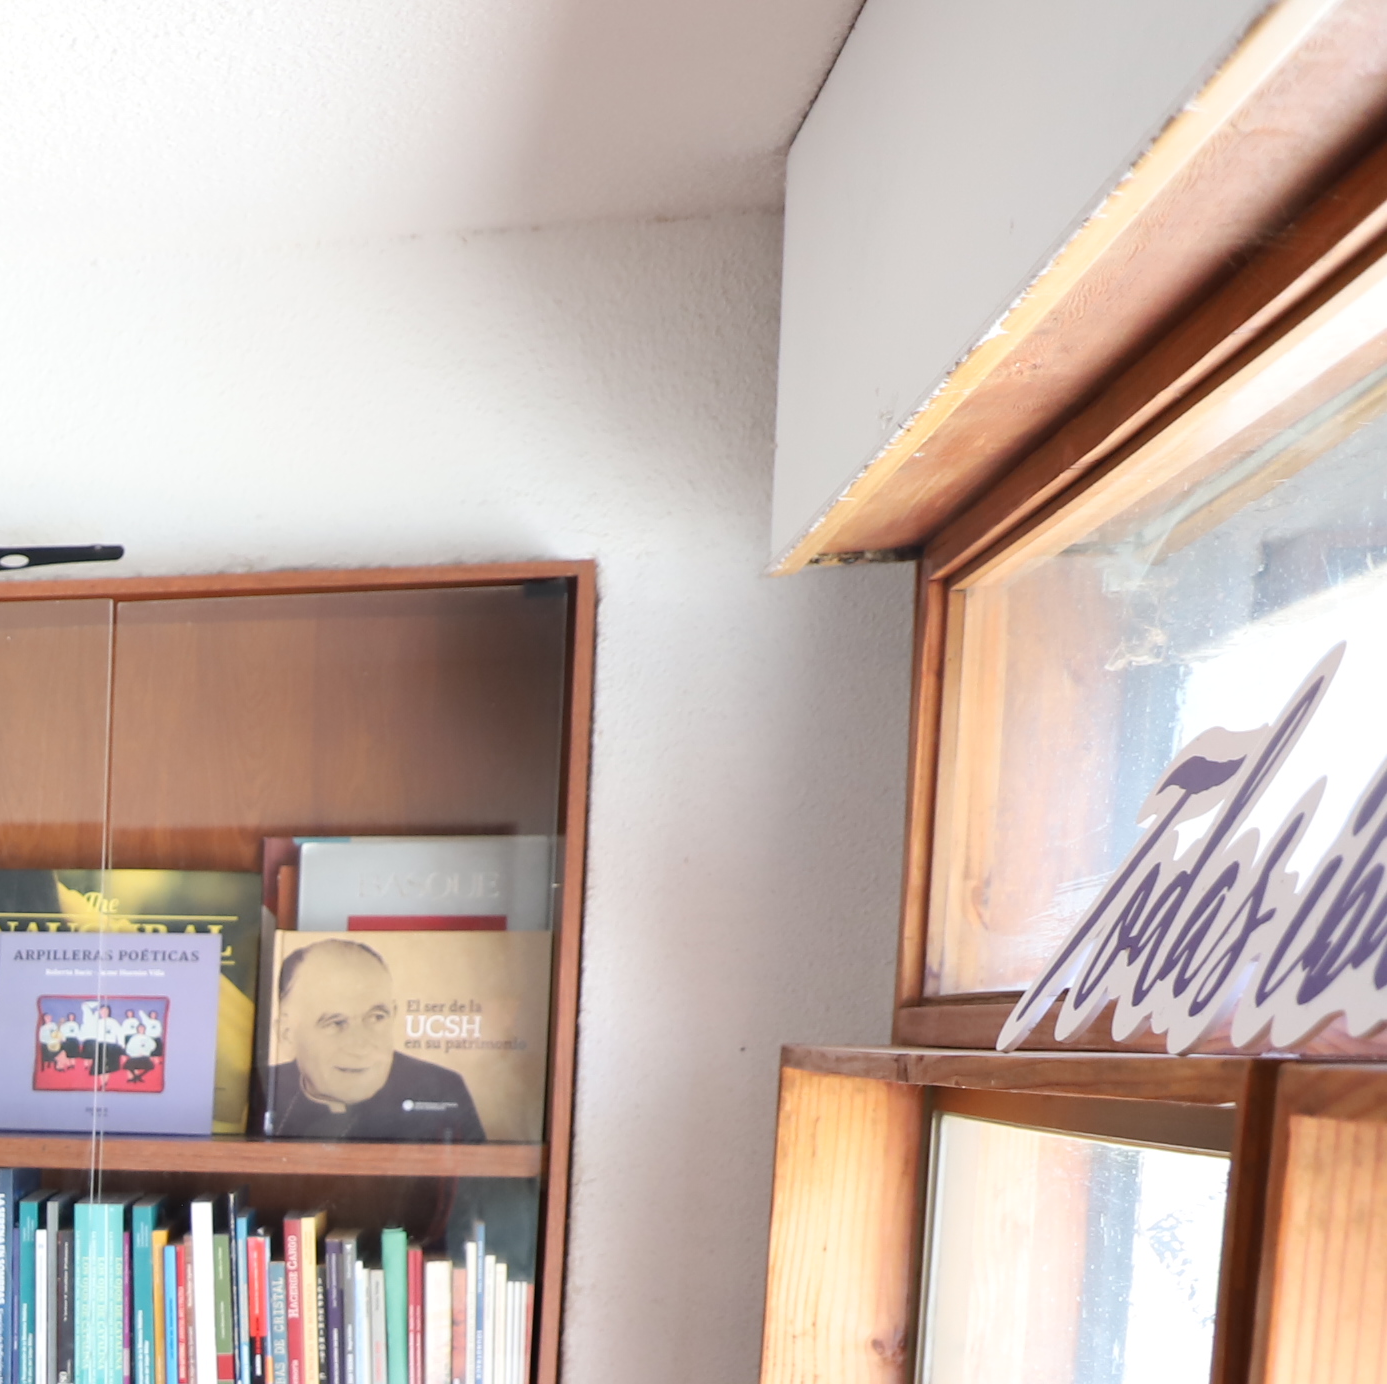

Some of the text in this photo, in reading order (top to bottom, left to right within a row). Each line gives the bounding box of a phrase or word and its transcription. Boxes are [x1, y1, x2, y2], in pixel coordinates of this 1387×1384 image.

[1016, 674, 1325, 1021] Todas
[83, 892, 120, 914] The
[13, 947, 200, 963] ARPILLERAS POÉTICAS
[407, 1000, 482, 1012] El ser de la
[405, 1015, 483, 1038] UCSH
[404, 1038, 527, 1052] en su patrimonio
[81, 1257, 89, 1276] LOS
[287, 1234, 300, 1318] HACERSE CARGO
[81, 1278, 89, 1302] OJOS
[81, 1304, 89, 1318] DE
[97, 1257, 105, 1369] LOS OJOS DE CATALINA
[115, 1257, 123, 1369] LOS OJOS DE CATALINA
[271, 1276, 284, 1333] CRISTAL
[81, 1321, 90, 1369] CATALINA
[272, 1339, 285, 1354] DE
